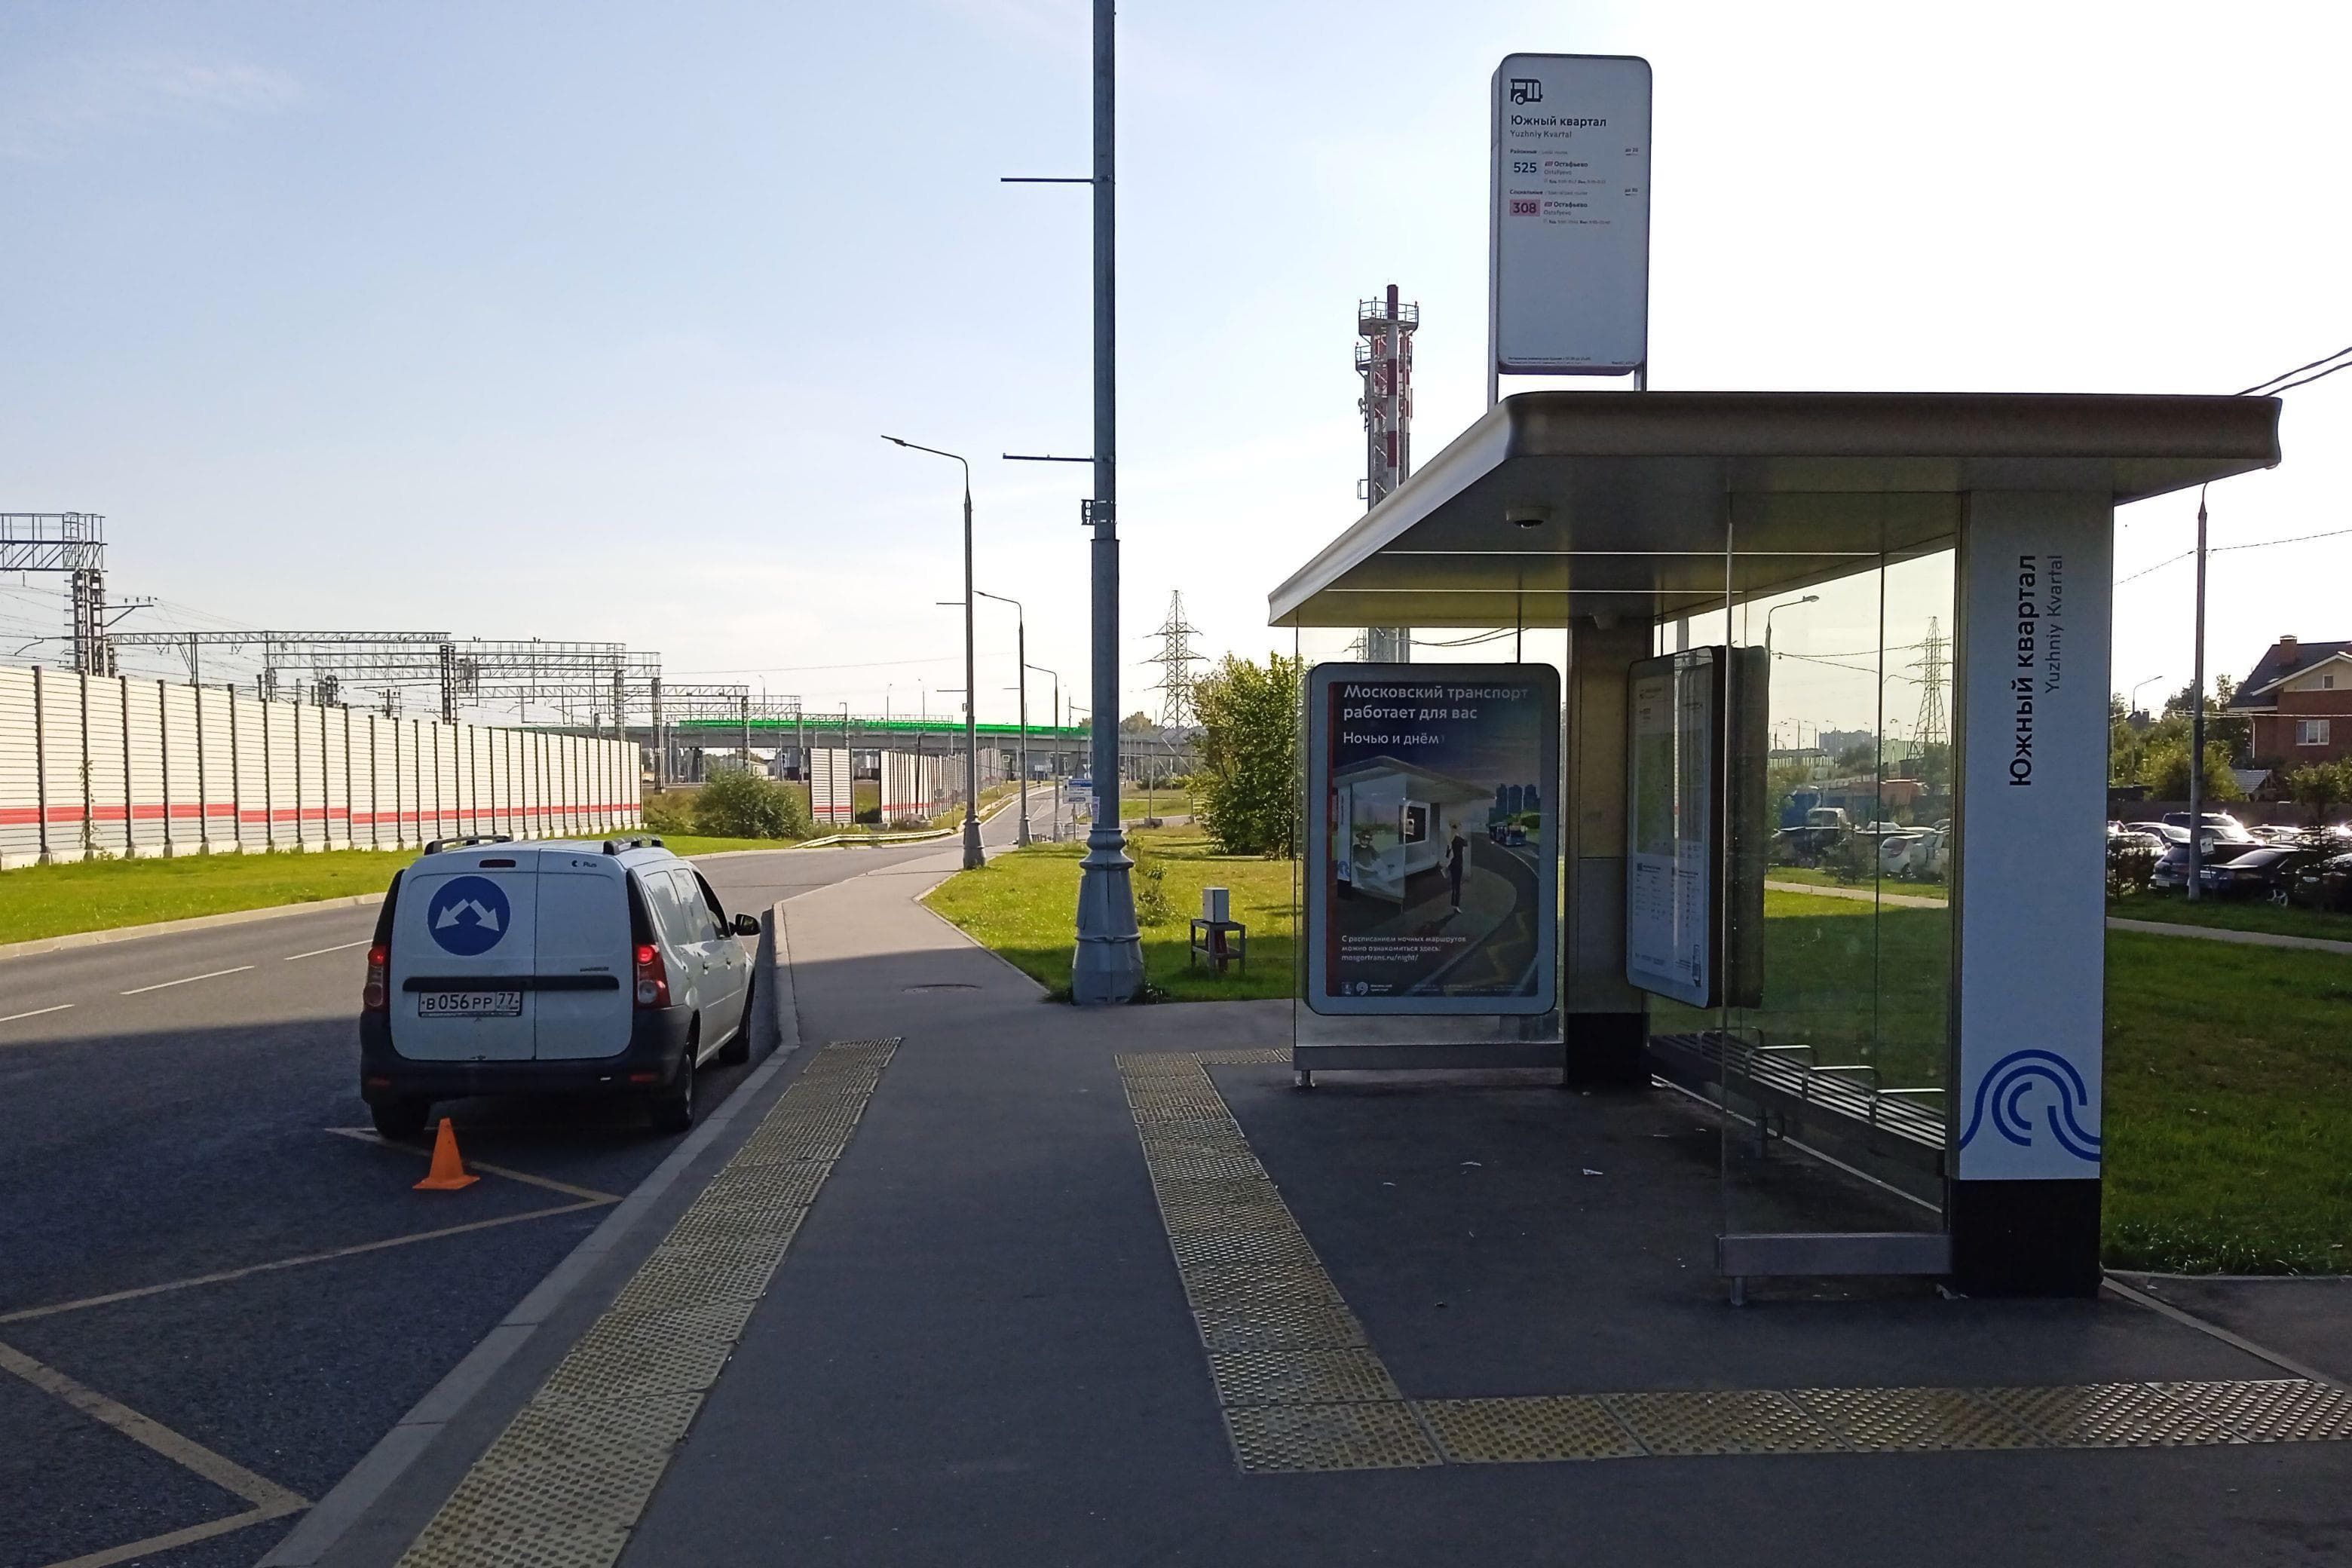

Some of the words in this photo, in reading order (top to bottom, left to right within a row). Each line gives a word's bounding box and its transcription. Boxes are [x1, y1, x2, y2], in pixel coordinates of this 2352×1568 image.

[1511, 115, 1557, 126] Южный
[1560, 118, 1606, 128] квартал
[1510, 130, 1542, 139] Yuzhniy
[1514, 162, 1537, 173] 525
[1513, 202, 1537, 213] 308
[2047, 555, 2063, 617] Kvartal
[2017, 555, 2040, 667] квартал
[2045, 623, 2064, 694] Yuzhniy
[1343, 684, 1443, 699] Московский
[1447, 688, 1528, 701] транспорт
[1343, 705, 1416, 721] работает
[1419, 709, 1447, 721] для
[1451, 709, 1478, 719] вас
[1343, 732, 1389, 744] Ночью
[1392, 734, 1400, 744] и
[1403, 733, 1439, 745] днём
[2009, 678, 2034, 786] Южный
[1349, 936, 1396, 945] расписанием
[1426, 936, 1466, 945] маршрутов
[1341, 954, 1419, 962] mosgortrans.ru/night/
[498, 992, 514, 1006] 77
